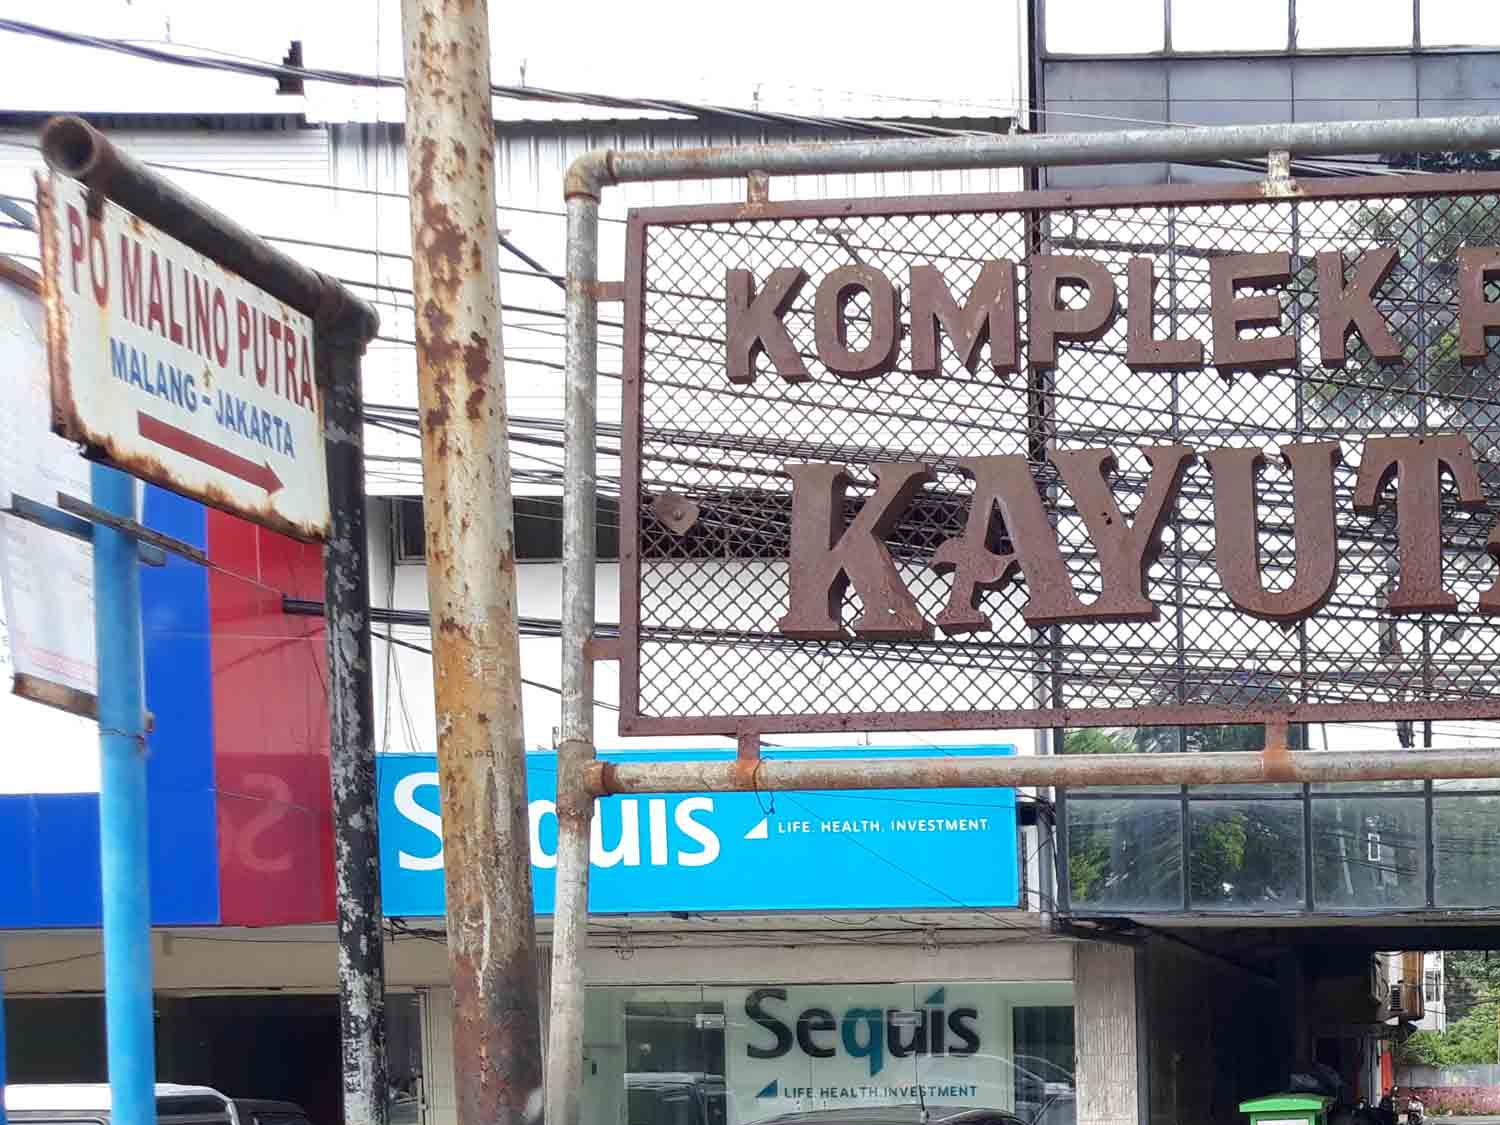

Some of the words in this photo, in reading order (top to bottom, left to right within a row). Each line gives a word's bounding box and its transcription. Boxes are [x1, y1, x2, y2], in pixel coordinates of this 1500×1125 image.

[67, 204, 108, 307] PO
[120, 234, 228, 368] MALINO
[237, 298, 316, 412] PUTRA
[725, 246, 1402, 384] KOMPLEK
[110, 336, 198, 413] MALANG
[216, 389, 295, 458] JAKARTA
[744, 985, 980, 1078] Sequis
